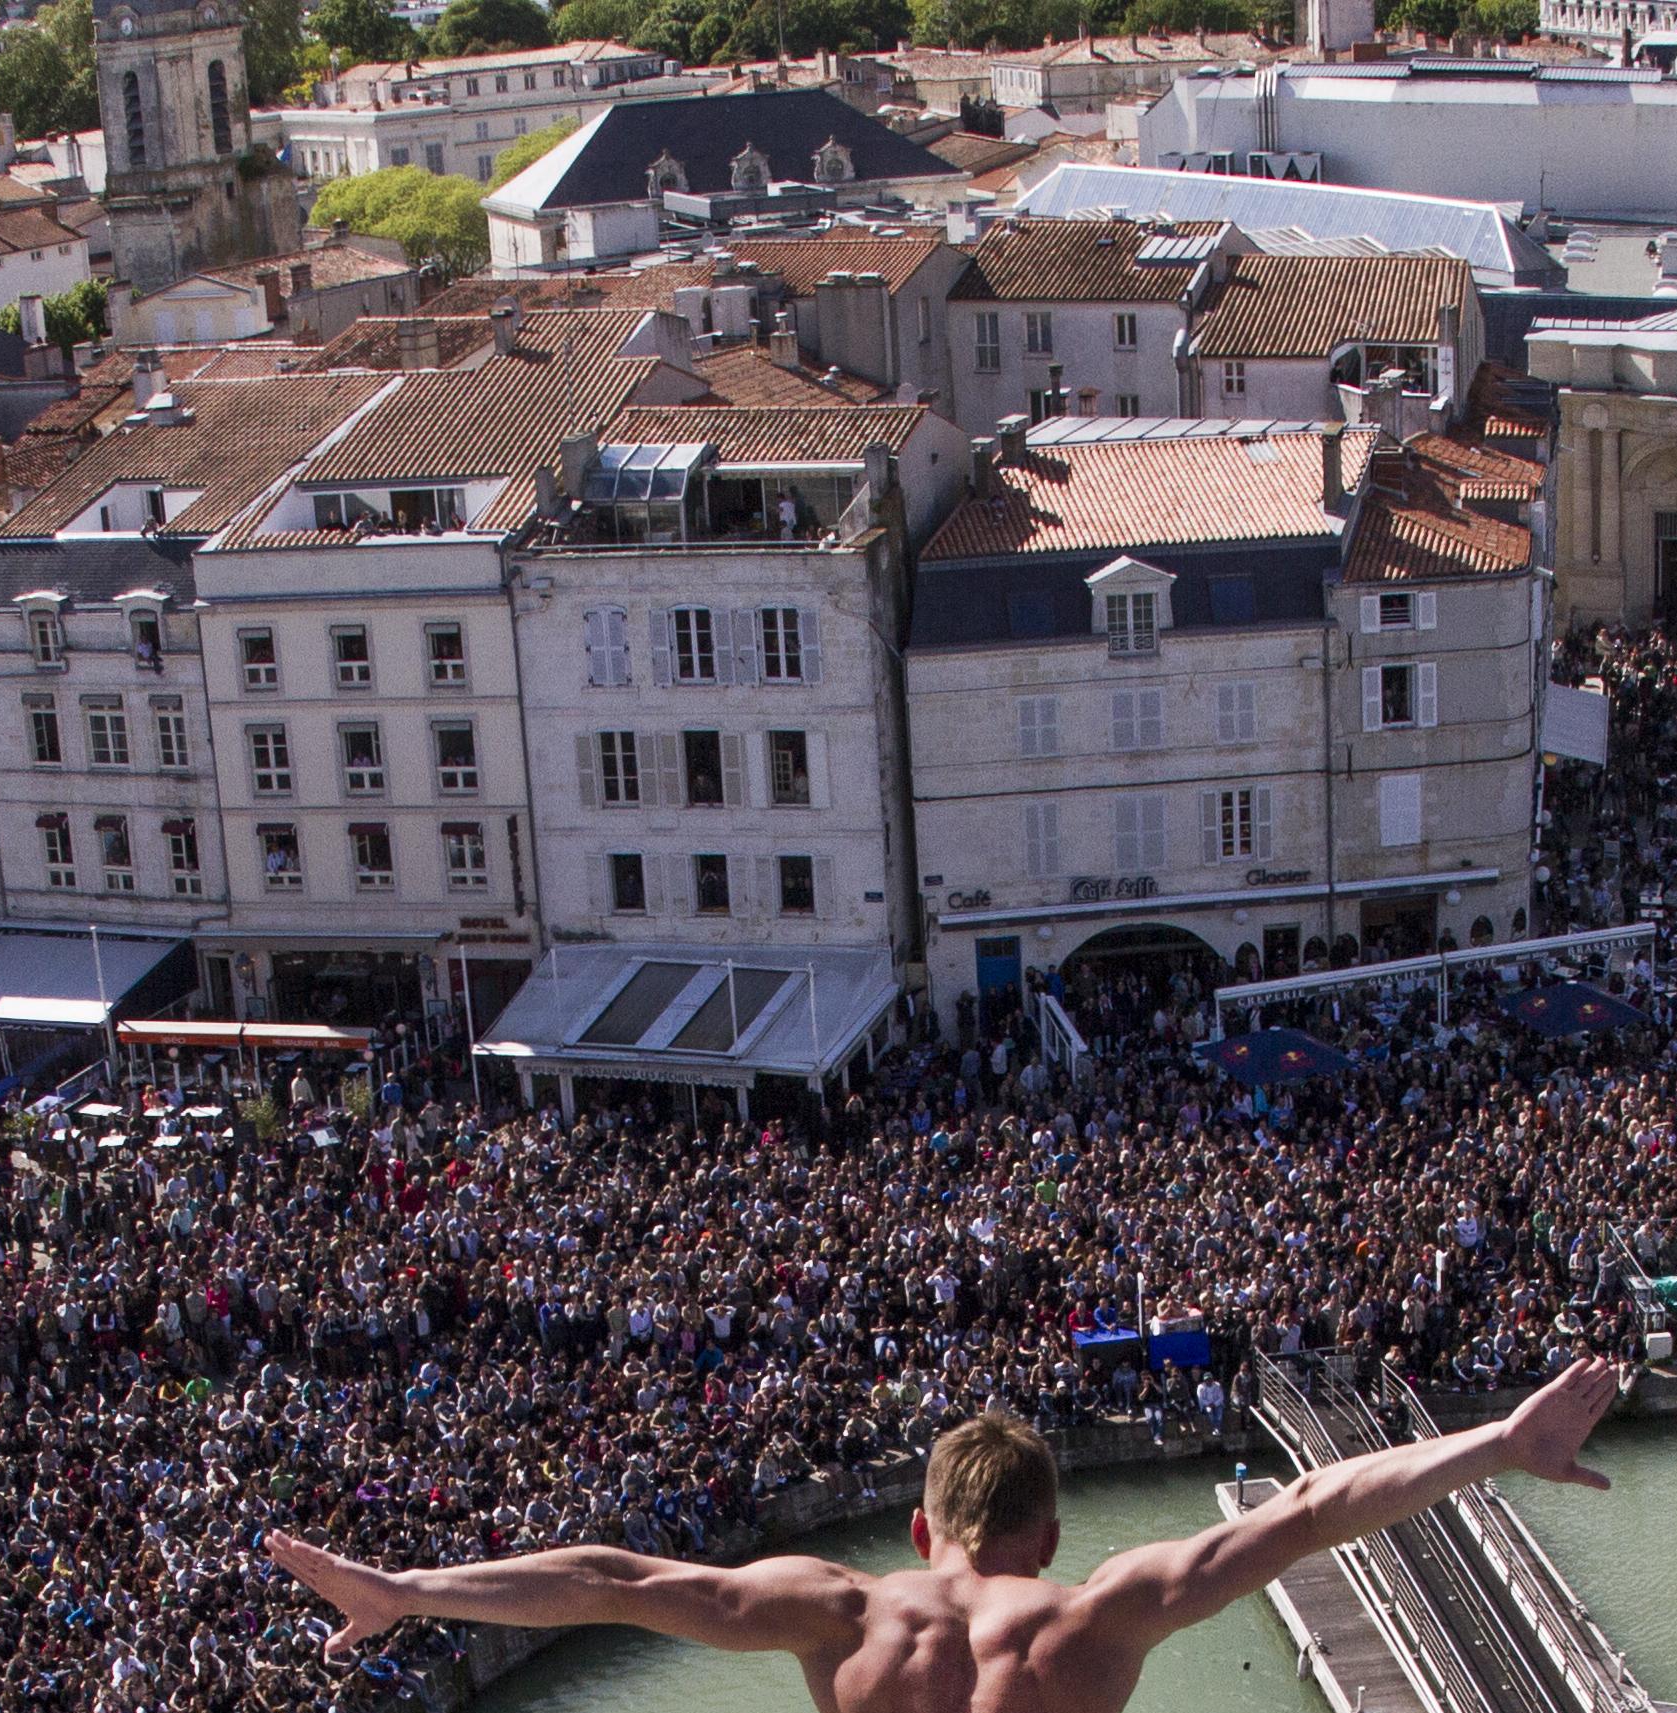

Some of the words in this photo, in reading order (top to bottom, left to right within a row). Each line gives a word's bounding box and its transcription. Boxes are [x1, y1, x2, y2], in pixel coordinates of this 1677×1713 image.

[1246, 868, 1311, 886] Glacier
[948, 889, 992, 909] Café
[1568, 937, 1639, 956] BRASSERIE
[1368, 970, 1425, 986] GLACIER
[272, 1038, 319, 1047] RESTAURANT
[581, 1067, 639, 1079] RESTAURANT
